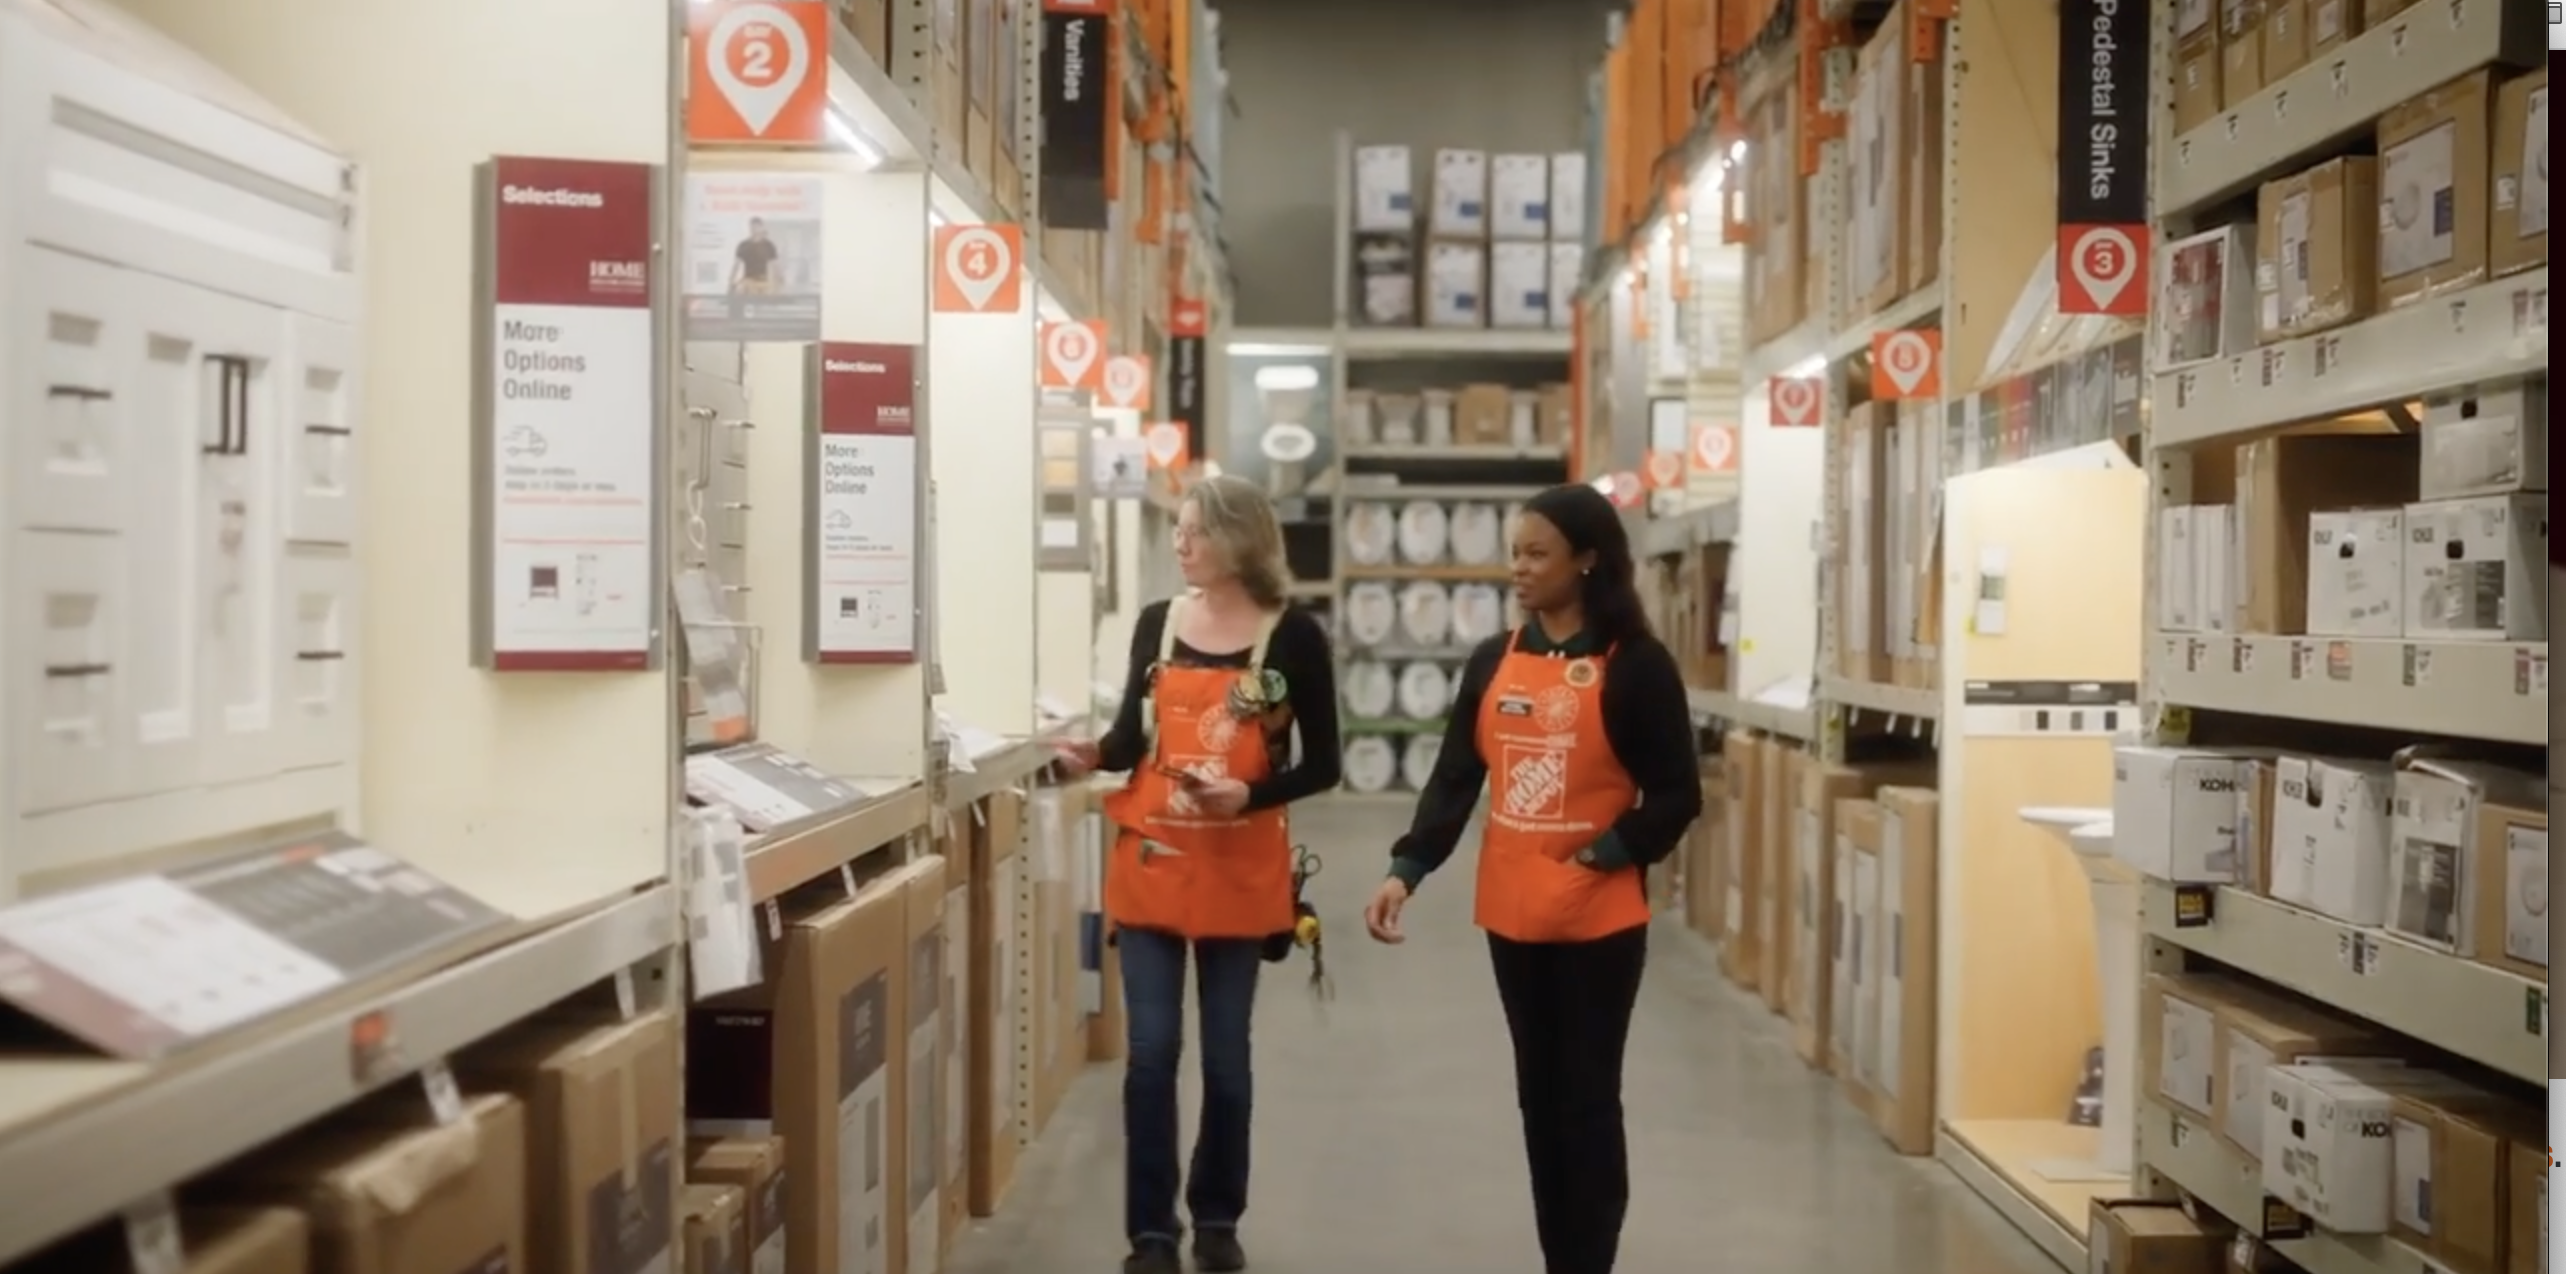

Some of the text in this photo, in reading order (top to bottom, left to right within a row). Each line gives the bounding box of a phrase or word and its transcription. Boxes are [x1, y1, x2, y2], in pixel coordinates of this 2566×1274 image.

[742, 40, 773, 78] 2
[1063, 18, 1085, 101] Vanities
[2090, 0, 2118, 200] Pedestal Sinks
[502, 184, 604, 208] Selections
[588, 259, 646, 279] HOME
[967, 250, 988, 275] 4
[2094, 250, 2114, 275] 3
[503, 319, 560, 342] More
[503, 348, 586, 374] Options
[825, 359, 887, 373] Selections
[502, 377, 573, 401] Online
[825, 443, 859, 458] More
[825, 461, 875, 478] Options
[825, 480, 867, 495] Online
[1506, 749, 1563, 815] HOME
[2200, 778, 2235, 792] KOH
